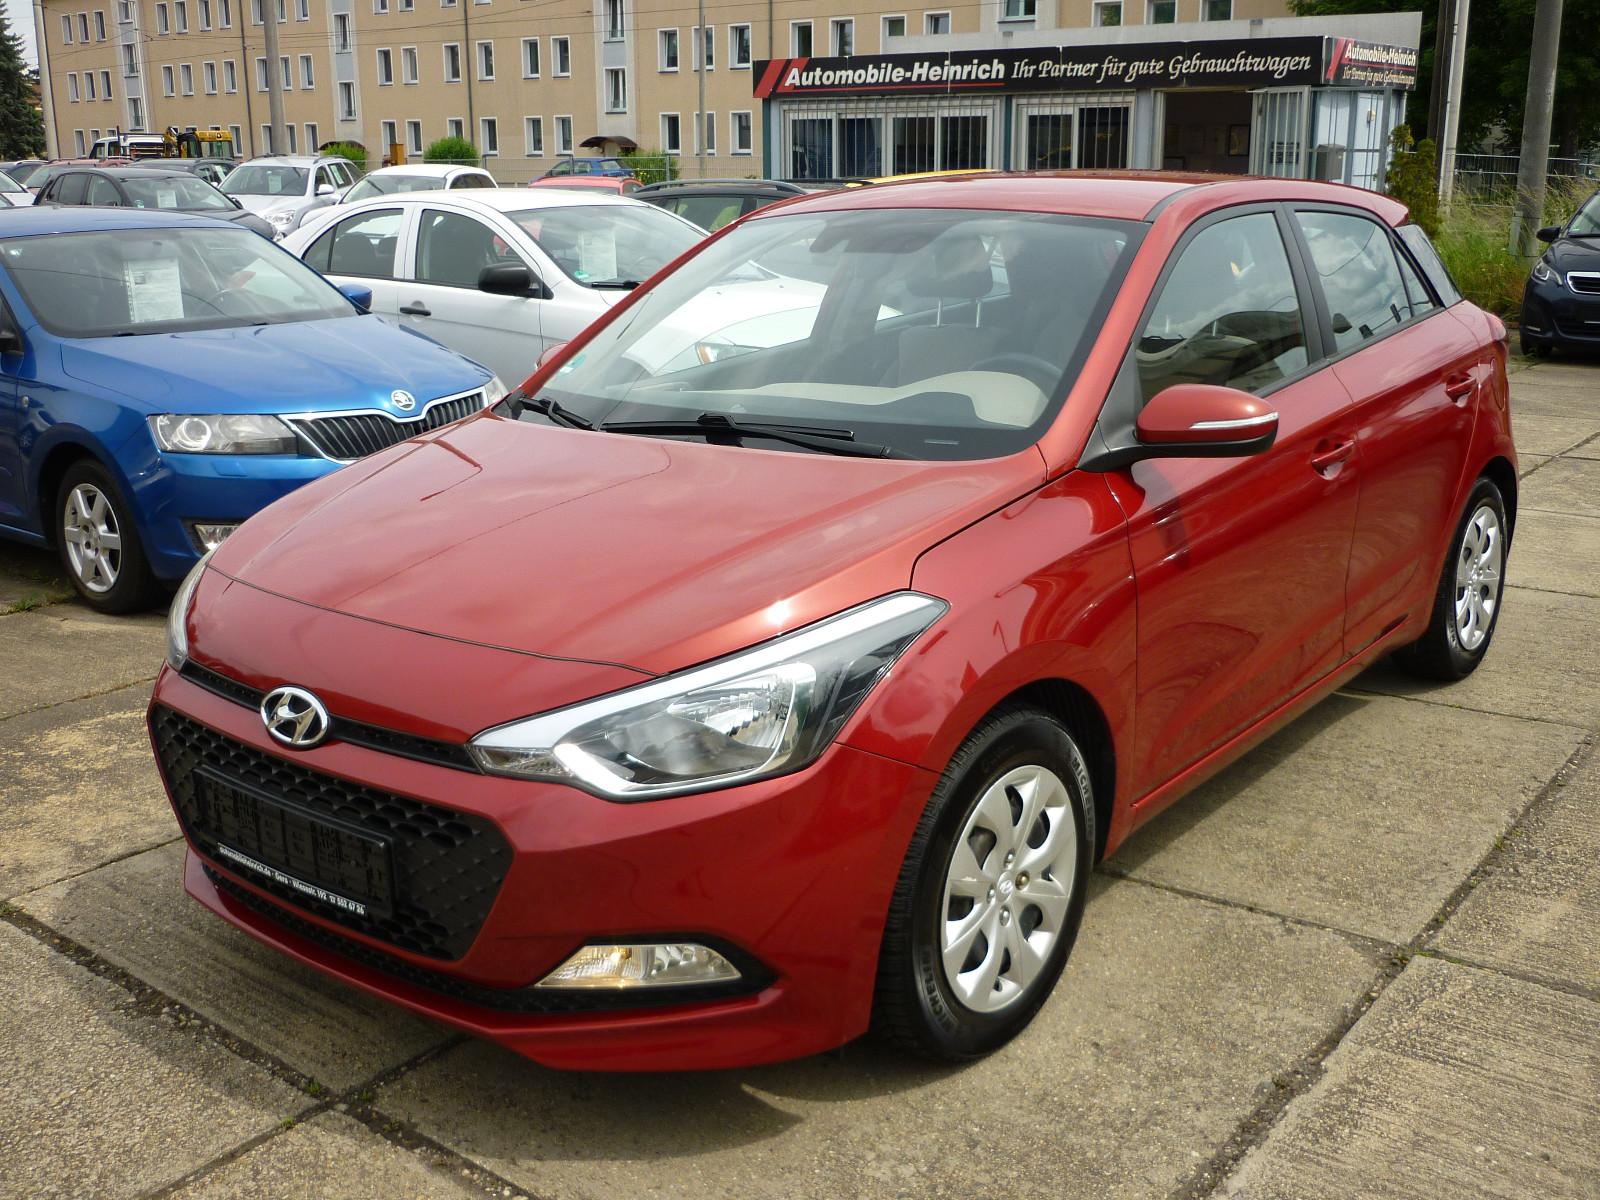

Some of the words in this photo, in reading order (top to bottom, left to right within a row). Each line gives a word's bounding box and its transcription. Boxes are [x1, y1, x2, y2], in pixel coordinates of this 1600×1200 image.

[784, 59, 1005, 87] Automobile-Heinrich
[1011, 59, 1036, 79] Ihr
[1038, 60, 1098, 78] Partner
[1096, 55, 1127, 83] für
[1124, 58, 1164, 83] gute
[1168, 50, 1311, 80] Gebrauchtwagen
[1344, 42, 1416, 67] Automobile-Heinrich
